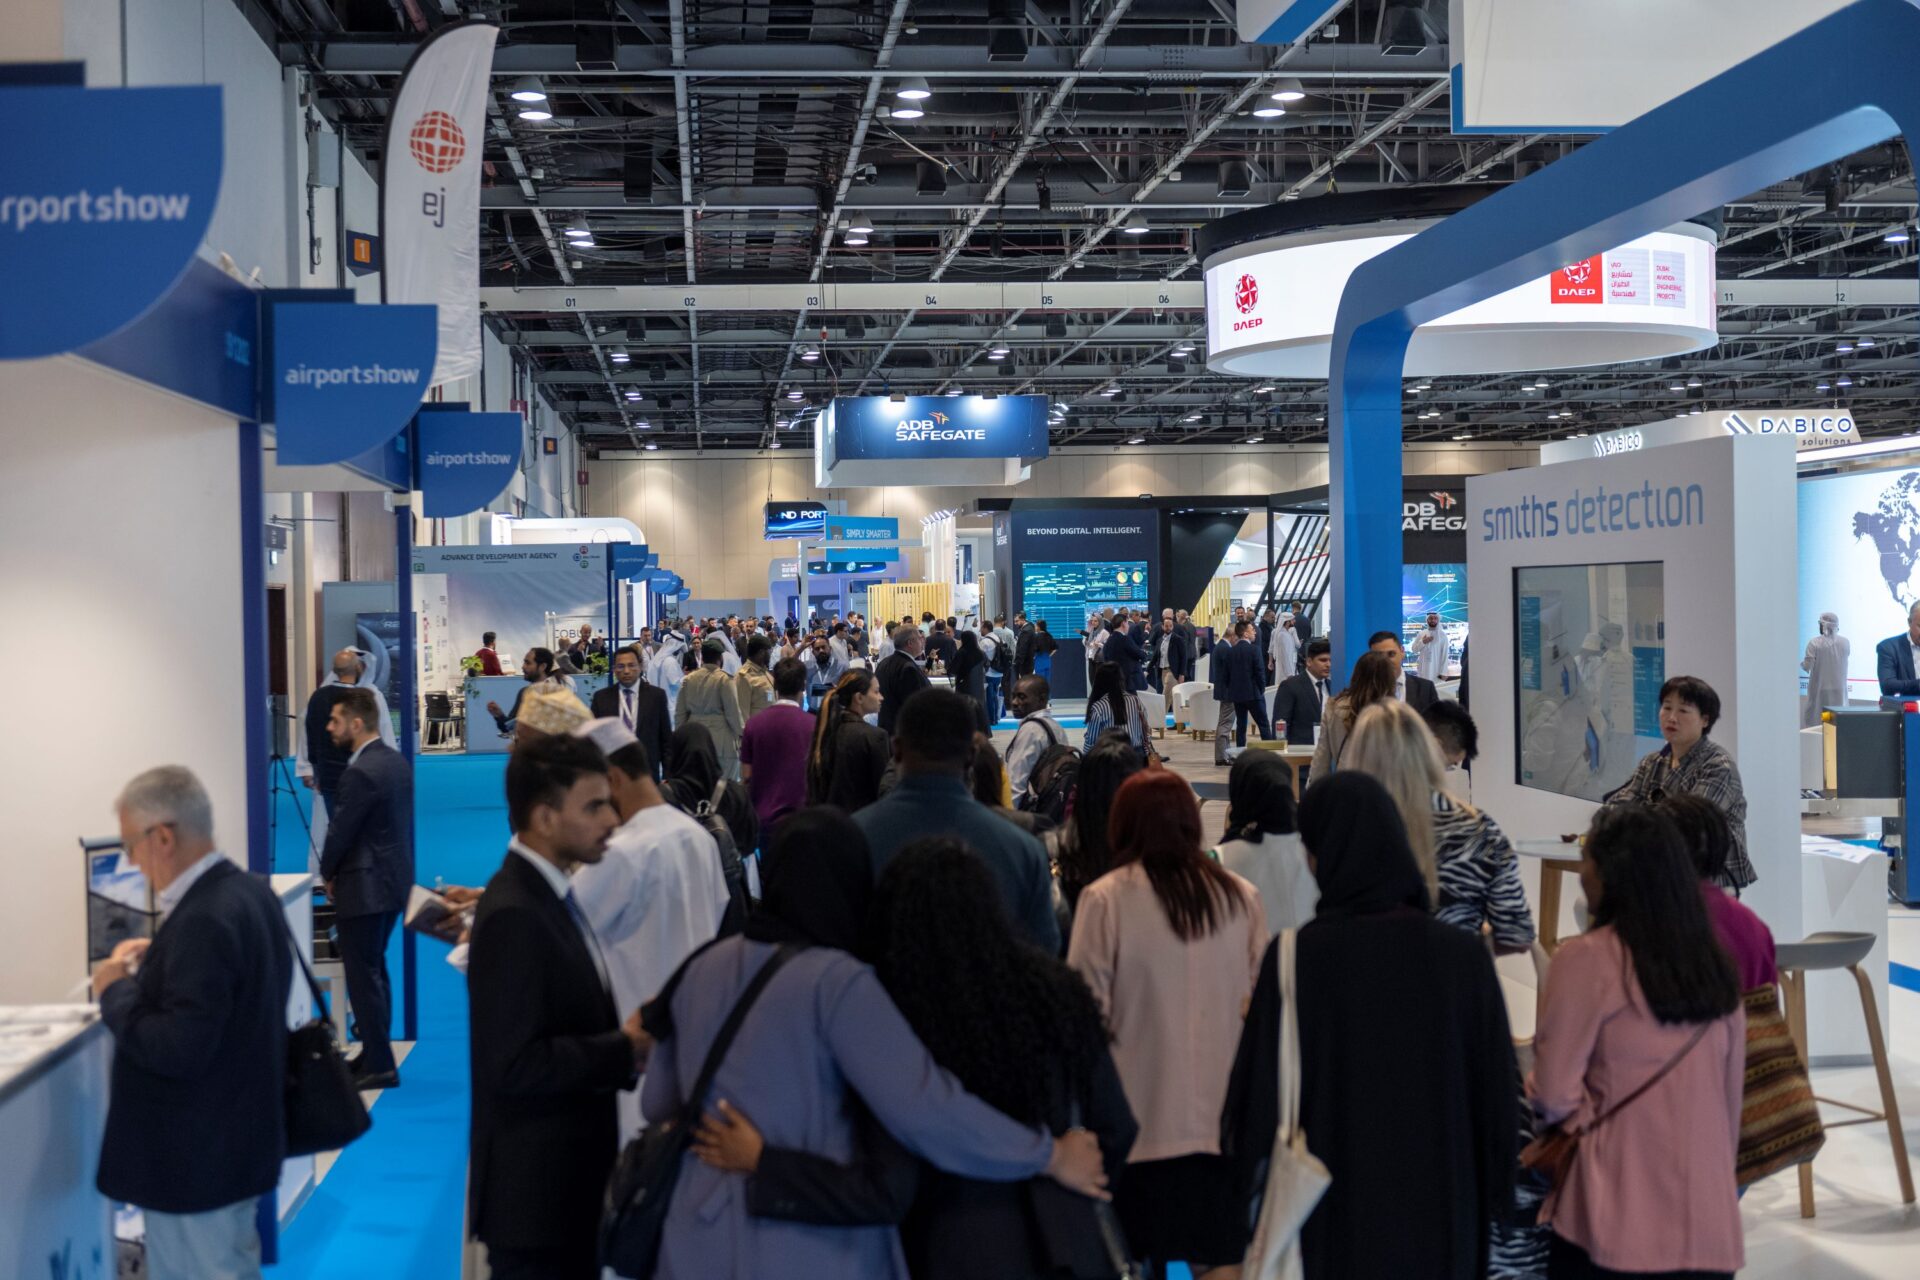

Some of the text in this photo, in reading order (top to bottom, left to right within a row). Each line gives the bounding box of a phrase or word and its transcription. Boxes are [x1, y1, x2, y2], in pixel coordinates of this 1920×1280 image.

[423, 187, 446, 228] ej
[359, 242, 367, 259] 1
[684, 297, 696, 307] 02
[806, 296, 819, 306] 03
[925, 296, 937, 305] 04
[1041, 295, 1053, 305] 05
[1158, 295, 1170, 304] 06
[1724, 293, 1734, 302] 11
[1835, 293, 1846, 302] 12
[565, 298, 576, 308] 01
[285, 363, 420, 390] airportshow
[896, 420, 935, 430] ADB
[895, 429, 986, 441] SAFEGATE
[1802, 436, 1851, 446] solutions
[425, 451, 511, 468] airportshow
[1402, 502, 1437, 517] DB
[1483, 480, 1704, 542] smiths detection
[846, 529, 865, 538] SIMPLY
[866, 529, 892, 539] SMARTER
[1060, 527, 1092, 535] DIGITAL.
[1093, 526, 1142, 535] INTELLIGENT.
[440, 553, 475, 561] ADVANCE
[475, 552, 528, 560] DEVELOPMENT
